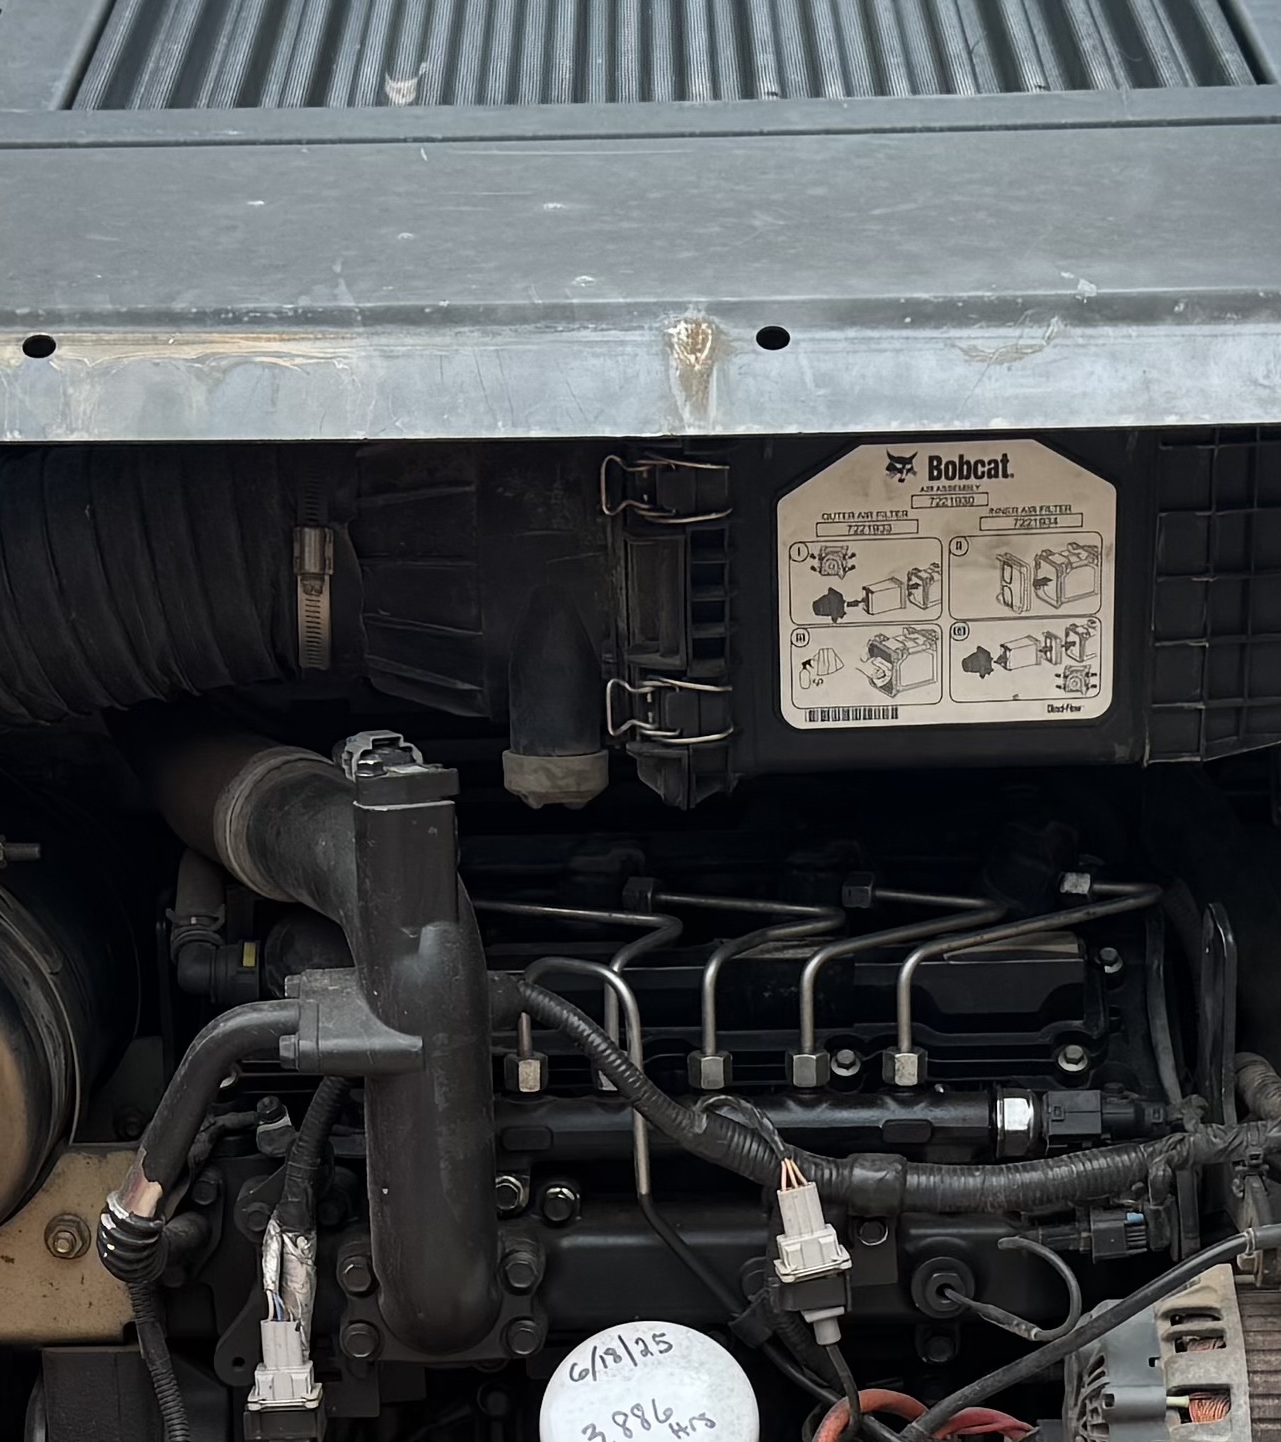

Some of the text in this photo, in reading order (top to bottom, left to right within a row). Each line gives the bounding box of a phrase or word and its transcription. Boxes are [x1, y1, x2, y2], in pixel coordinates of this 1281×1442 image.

[928, 453, 1011, 481] Bobcat
[875, 510, 909, 519] FILTER
[1038, 504, 1072, 514] FILTER
[569, 1332, 674, 1383] 6/18/25
